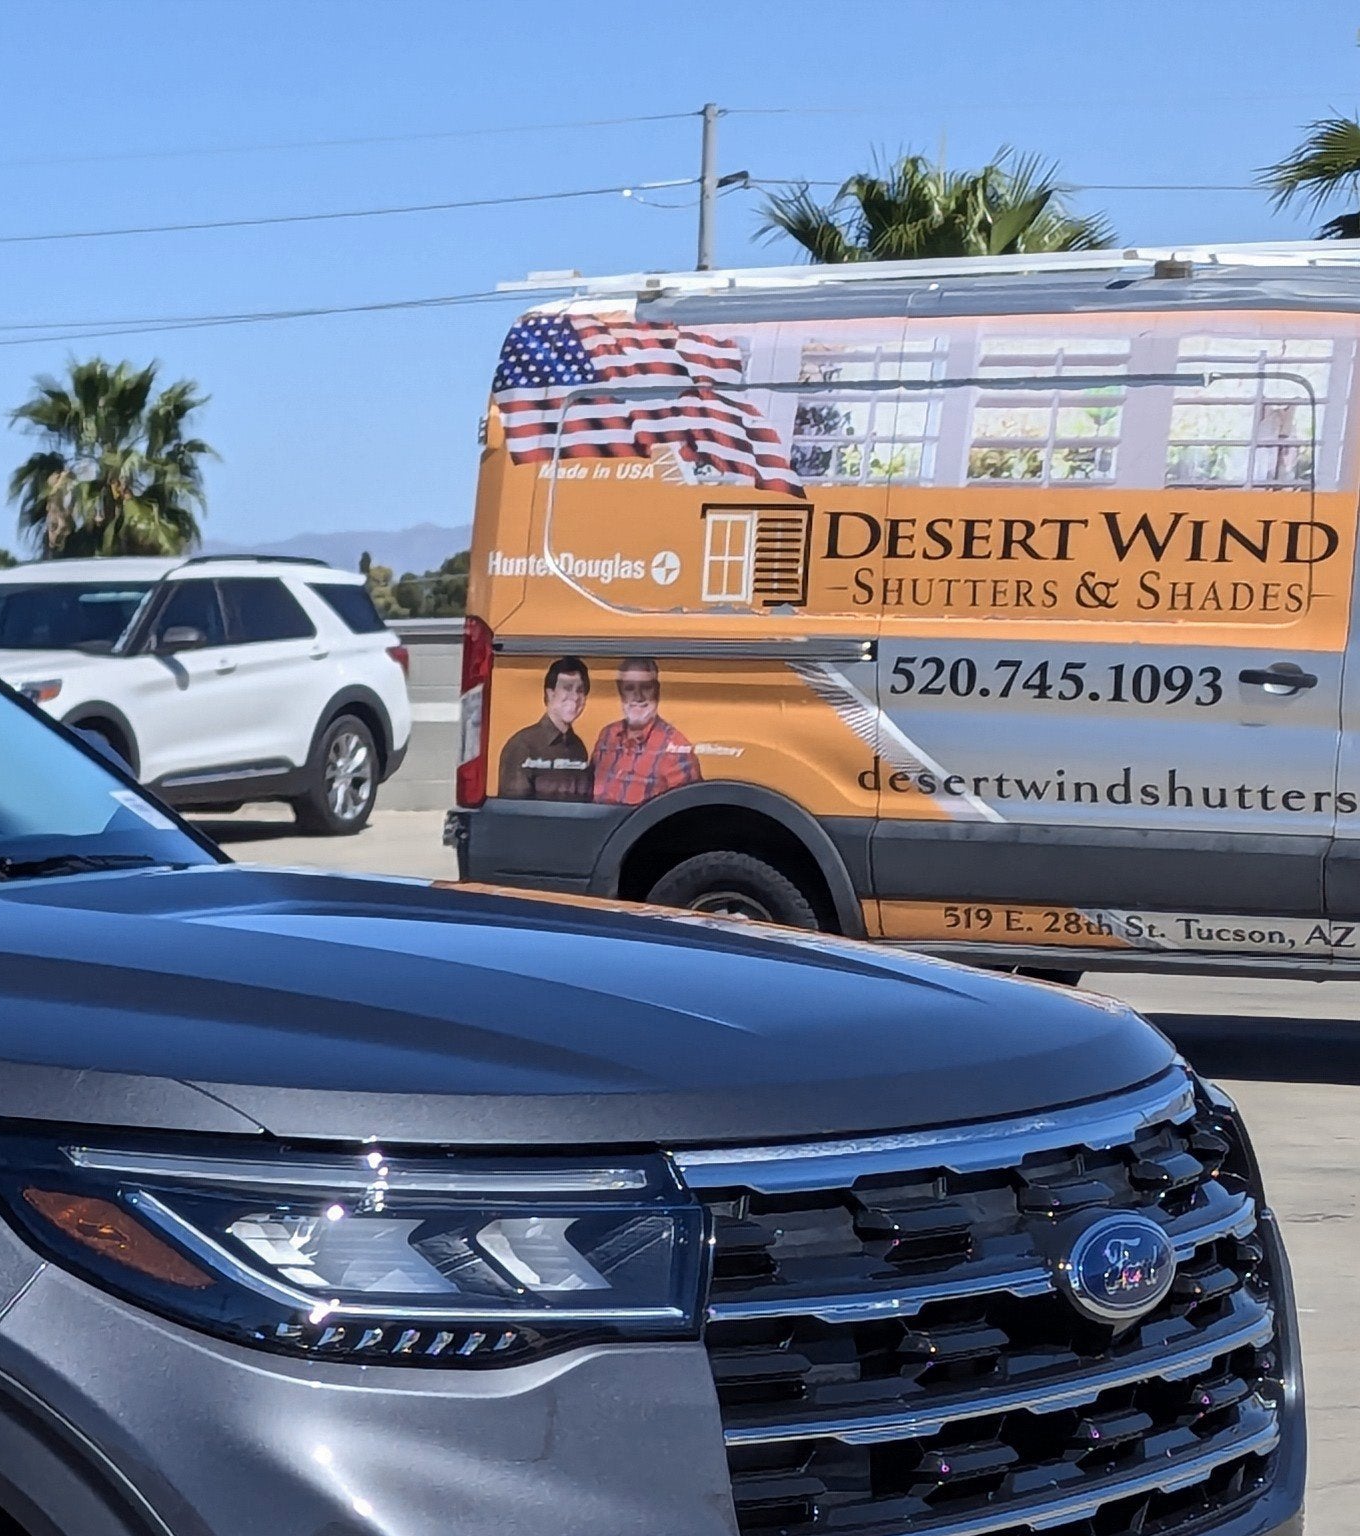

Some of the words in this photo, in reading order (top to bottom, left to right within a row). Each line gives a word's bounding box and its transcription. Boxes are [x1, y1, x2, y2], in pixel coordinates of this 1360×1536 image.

[538, 463, 589, 479] Made
[616, 463, 655, 480] USA
[820, 511, 1089, 561] DESERT
[1099, 511, 1340, 563] WIND
[852, 567, 1058, 608] SHUTTERS
[1075, 571, 1120, 608] &
[1137, 570, 1304, 613] SHADES
[889, 655, 1224, 707] 520.745.1093
[943, 907, 993, 930] 519
[1005, 910, 1034, 932] E.
[1043, 911, 1113, 936] 28th
[1124, 915, 1166, 938] St.
[1176, 918, 1296, 949] Tucson,
[1304, 924, 1357, 948] AZ
[1104, 1237, 1159, 1295] Ford
